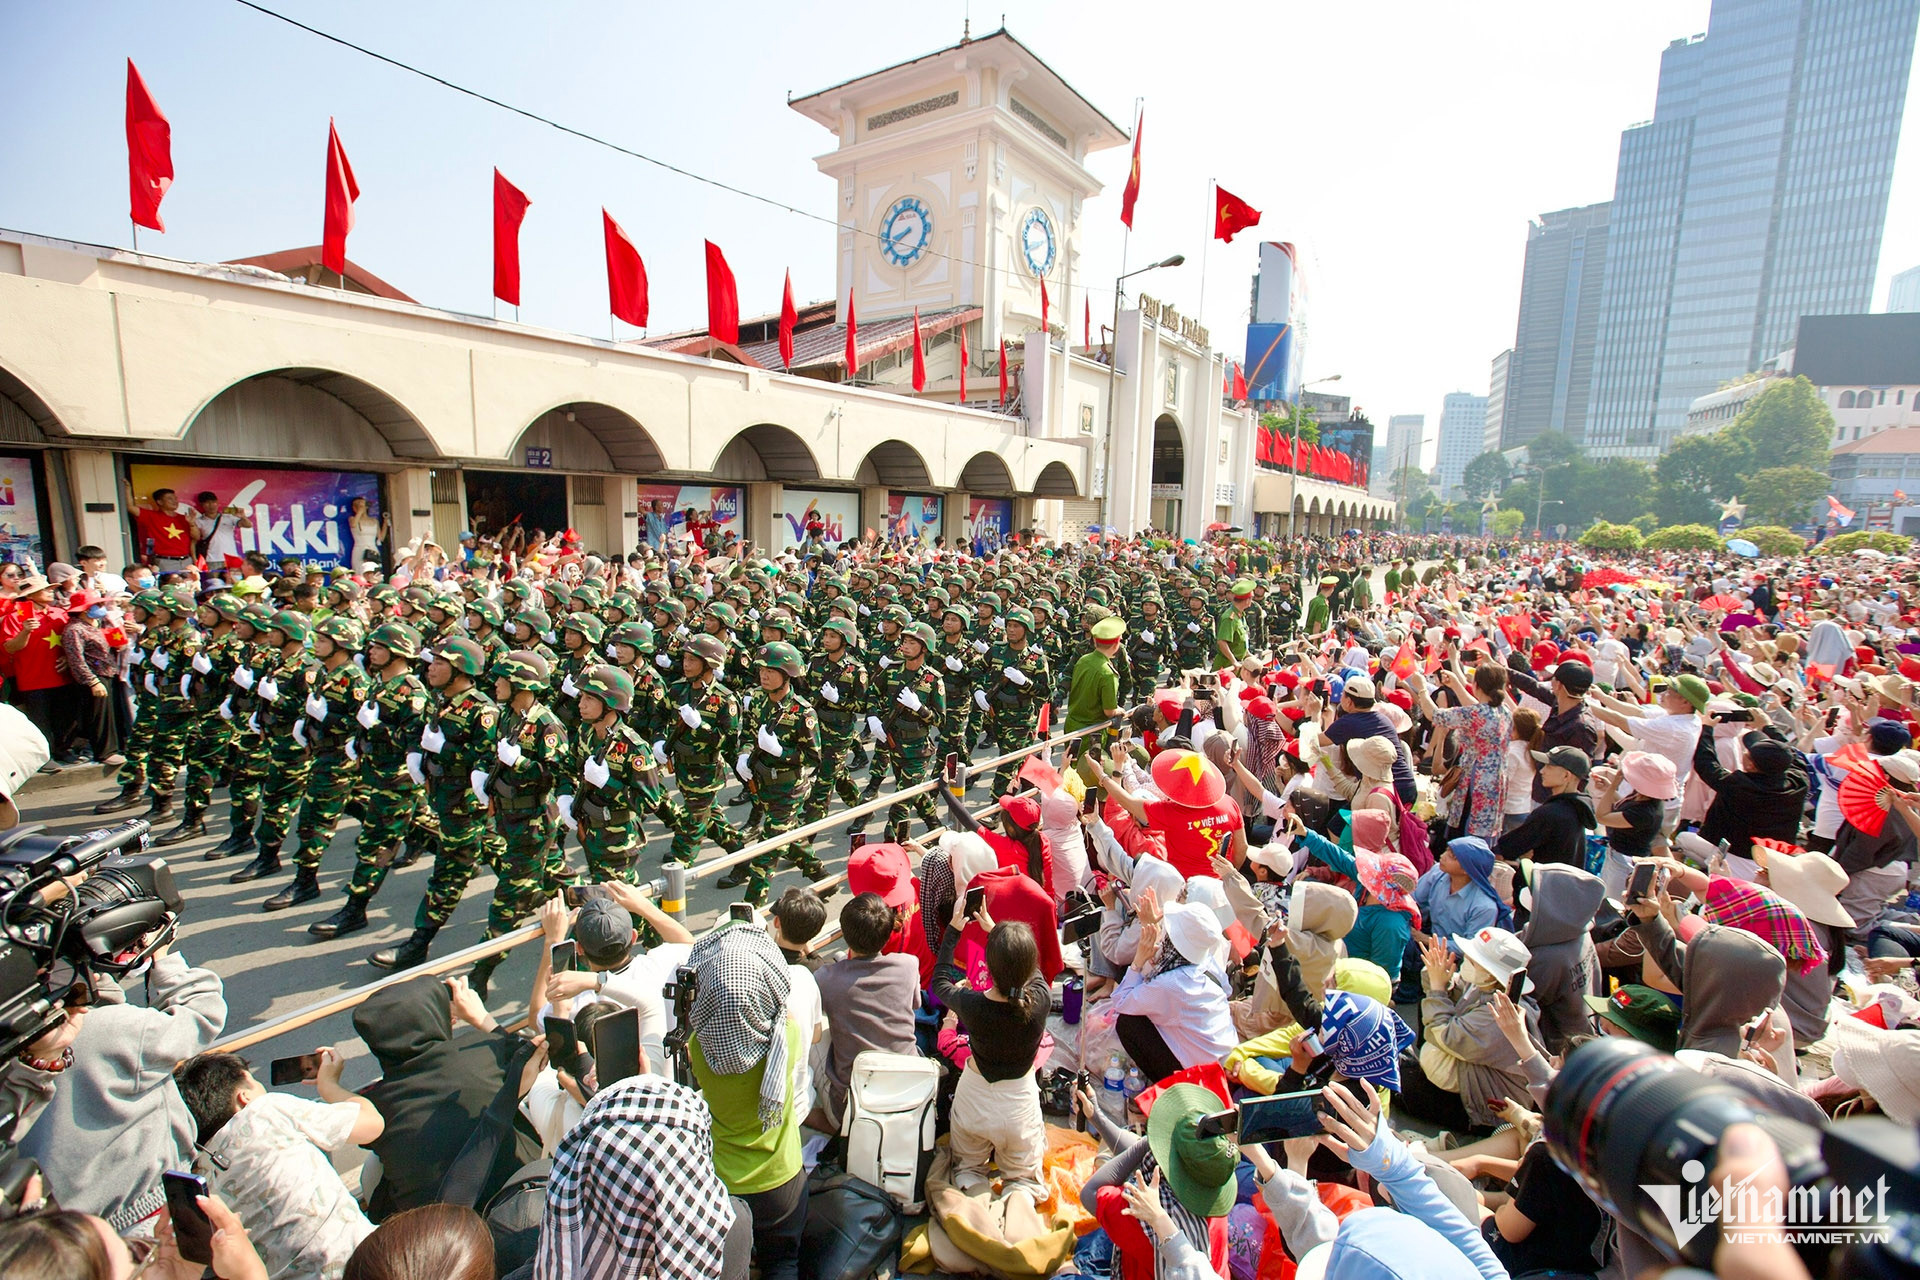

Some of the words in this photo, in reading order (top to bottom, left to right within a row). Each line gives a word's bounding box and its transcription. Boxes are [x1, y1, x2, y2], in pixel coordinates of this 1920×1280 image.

[542, 450, 550, 465] 2
[711, 493, 736, 512] Vikki
[785, 497, 843, 542] Vki
[1188, 822, 1193, 830] I
[1201, 816, 1215, 827] VIỆT
[1216, 814, 1228, 824] NAM
